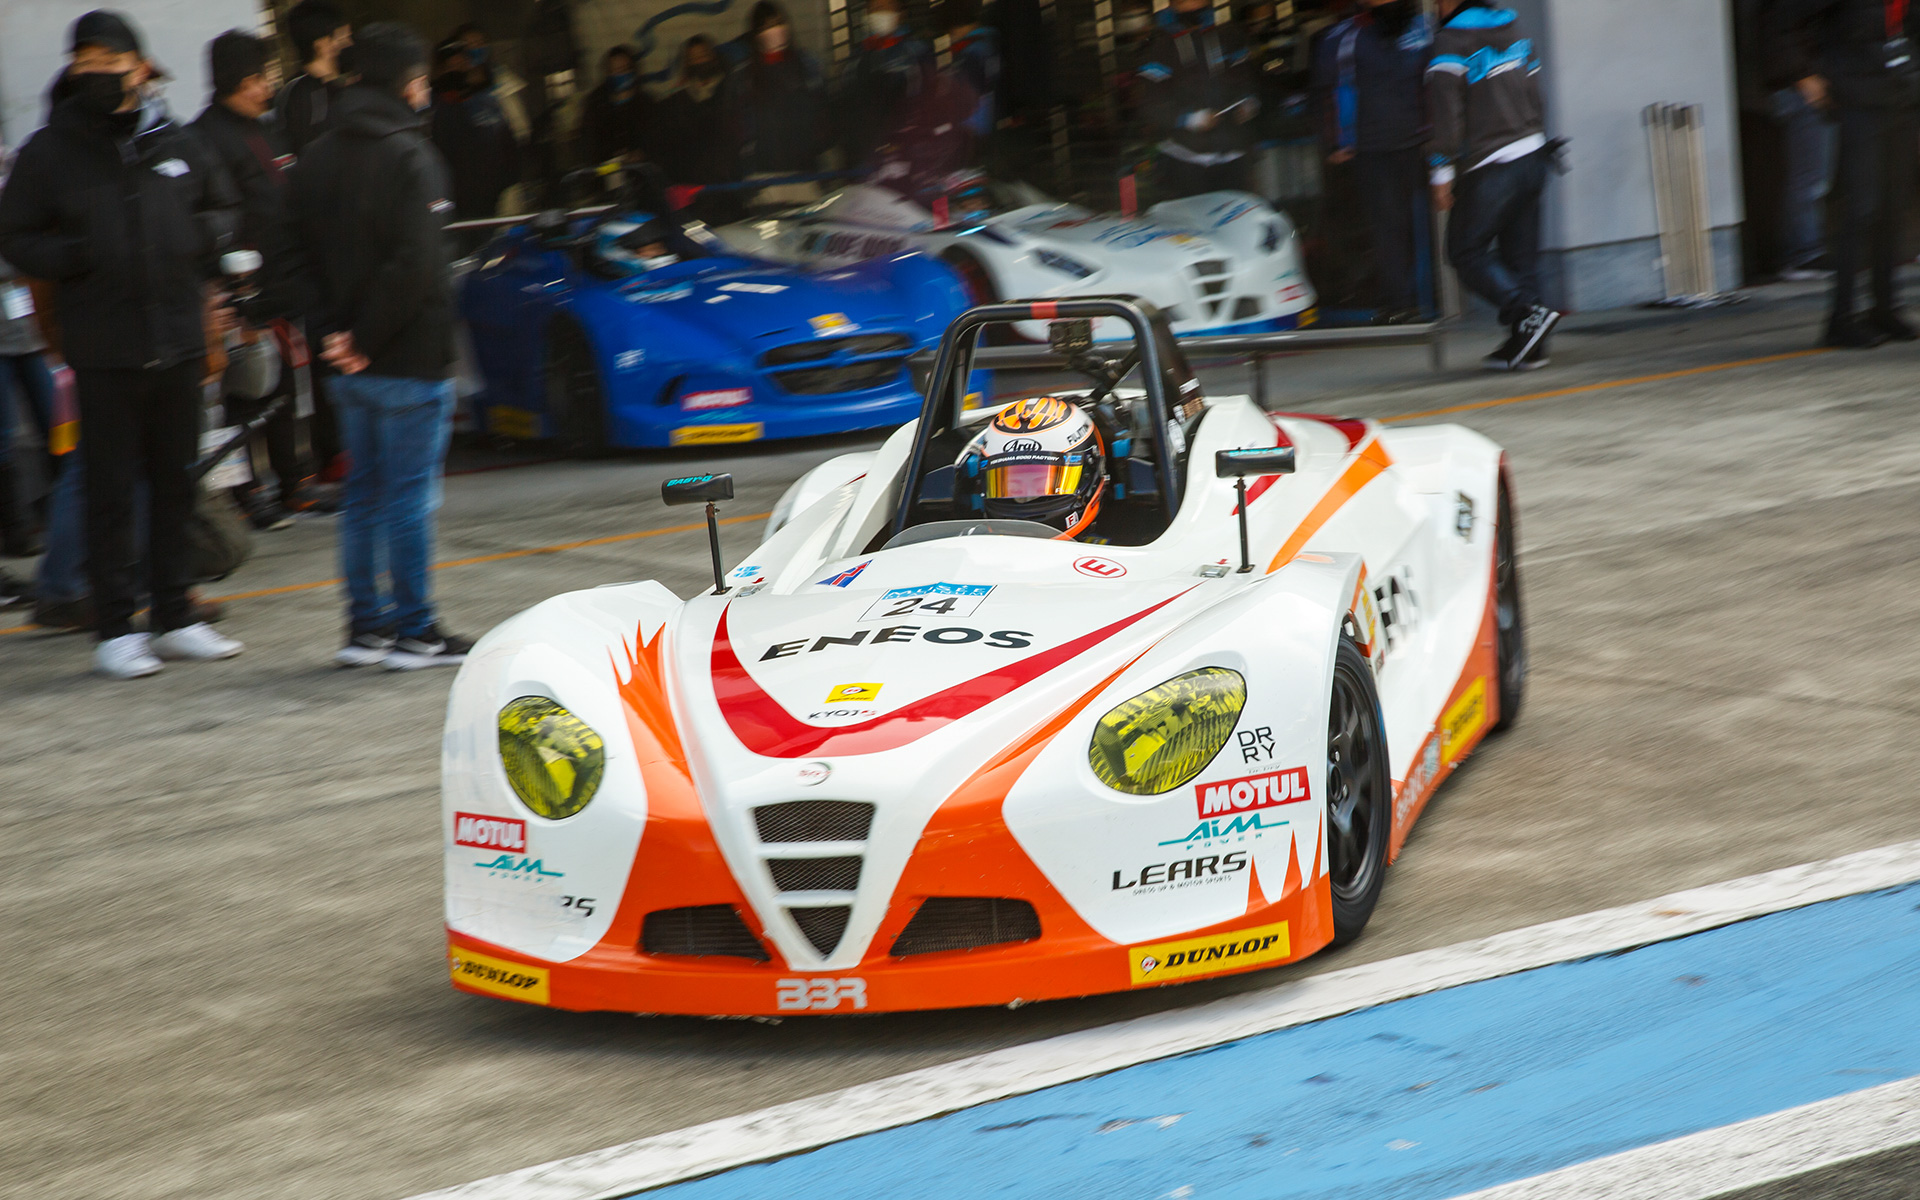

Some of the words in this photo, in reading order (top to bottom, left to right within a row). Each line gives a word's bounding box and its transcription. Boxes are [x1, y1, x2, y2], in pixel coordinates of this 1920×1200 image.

[1006, 440, 1037, 452] Arai
[1079, 559, 1120, 576] E
[881, 597, 959, 618] 24
[758, 625, 1035, 662] ENEOS
[1202, 771, 1306, 815] MOTUL
[456, 816, 525, 849] MOTUL
[1111, 850, 1248, 891] LEARS
[1164, 934, 1279, 969] DUNLOP
[462, 960, 541, 990] DUNLOP
